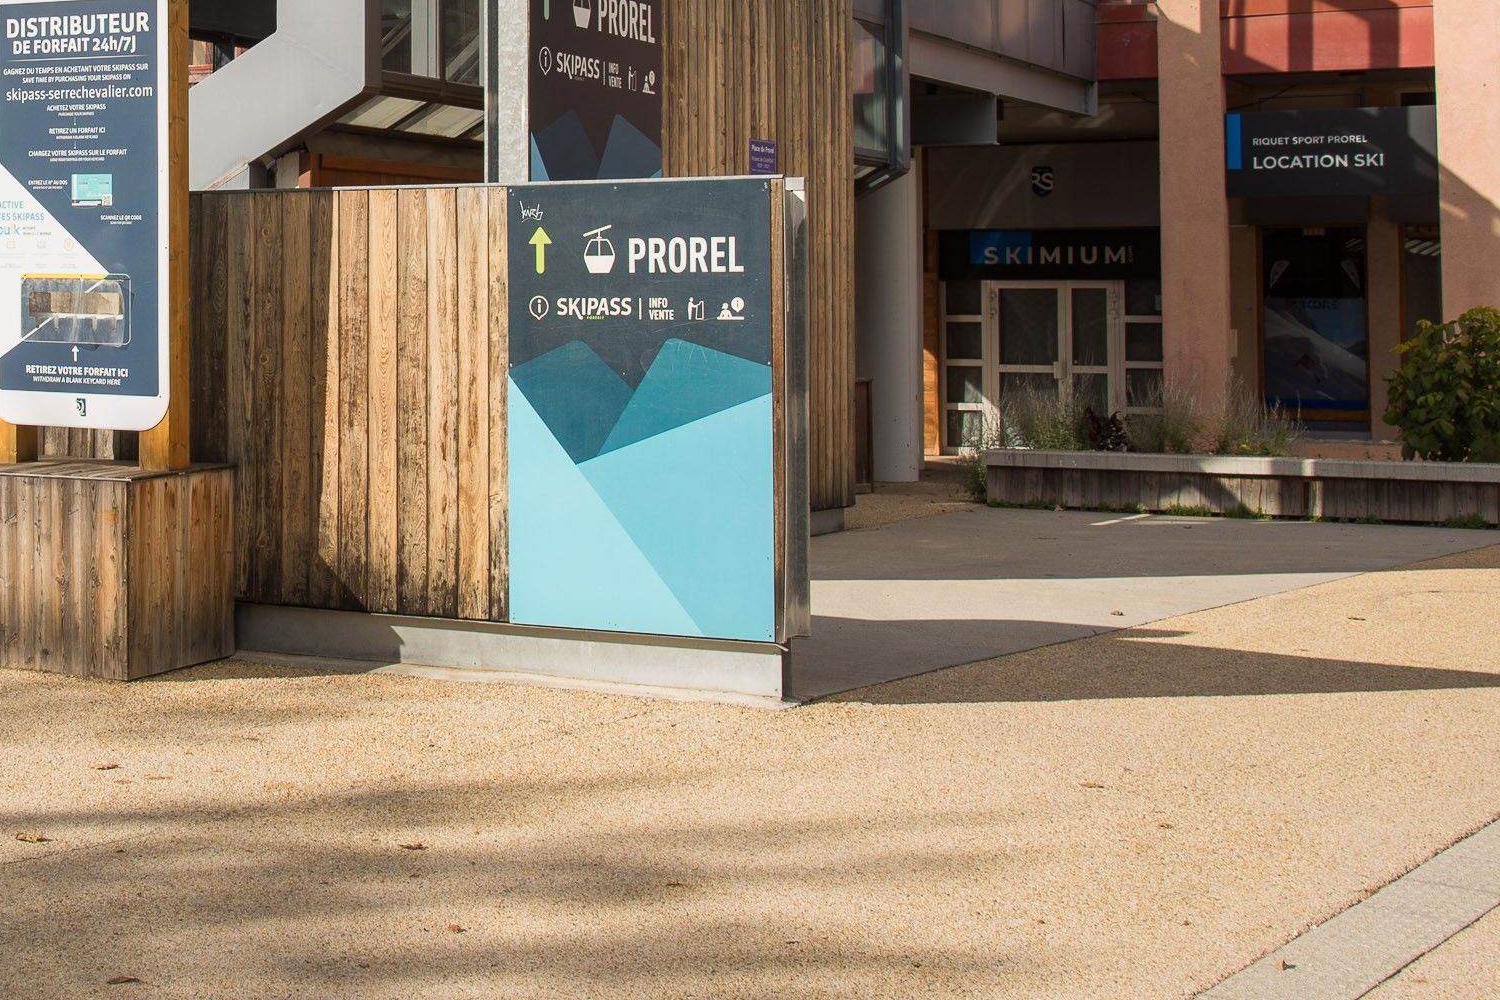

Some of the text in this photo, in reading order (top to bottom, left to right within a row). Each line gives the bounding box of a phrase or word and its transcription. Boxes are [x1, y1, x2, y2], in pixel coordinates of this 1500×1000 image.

[6, 12, 150, 39] DISTRIBUTEUR
[12, 34, 136, 55] DE FORFAIT 24h/7J
[3, 63, 149, 76] GAGNEZ DU TEMPS EN ACHETANT VOTRE SKIPASS SUR
[556, 52, 600, 80] SKIPASS
[55, 74, 87, 83] PURCHASING
[102, 73, 123, 81] SKIPASS
[6, 85, 153, 104] skipass-serrechevalier.com
[47, 104, 69, 112] ACHETEZ
[85, 103, 107, 111] SKIPASS
[49, 127, 69, 135] RETIREZ
[1252, 134, 1368, 146] RIQUET SPORT PROREL
[28, 149, 51, 157] CHARGEZ
[51, 149, 67, 157] VOTRE
[100, 148, 106, 156] LE
[106, 148, 128, 156] FORFAIT
[1252, 152, 1384, 169] LOCATION SKI
[12, 212, 45, 221] SKIPASS
[628, 236, 745, 274] PROREL
[984, 245, 1126, 265] SKIMIUM
[556, 296, 668, 321] SKIPASS INFO
[648, 309, 675, 320] VENTE
[25, 365, 129, 378] RETIREZ VOTRE FORFAIT ICI
[33, 375, 61, 383] WITHDRAW
[83, 377, 106, 385] KEYCARD
[107, 378, 121, 386] HERE
